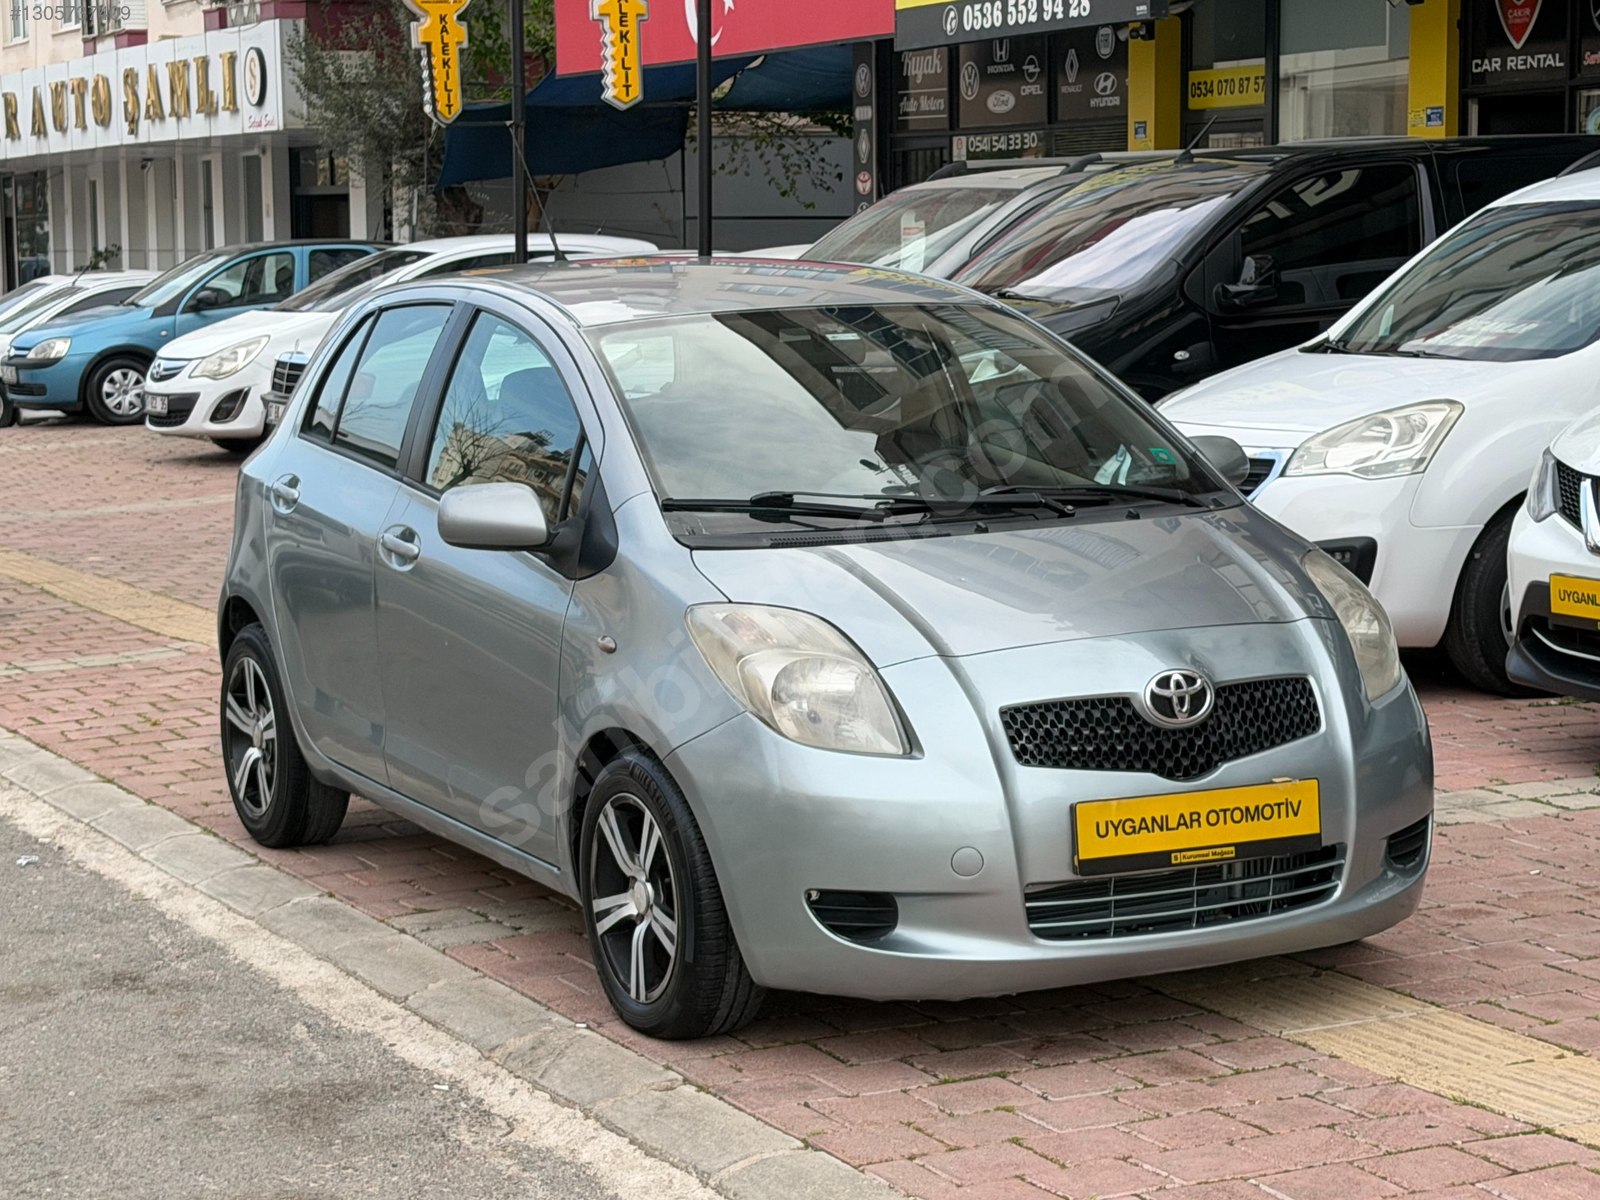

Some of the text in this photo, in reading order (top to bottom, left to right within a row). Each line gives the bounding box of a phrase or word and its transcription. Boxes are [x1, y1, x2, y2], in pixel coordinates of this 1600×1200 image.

[963, 5, 1003, 31] 0536
[1007, 1, 1038, 26] 552
[1043, 0, 1064, 21] 94
[986, 64, 1015, 74] HONDA
[1472, 53, 1565, 73] CAR RENTAL
[30, 73, 112, 138] AUTO
[122, 50, 239, 136] ŞAMLI
[1020, 85, 1043, 96] OPEL
[1191, 75, 1265, 98] 0534 070 87 57
[1090, 96, 1120, 107] HYUNDAI
[1009, 134, 1022, 150] 33
[1024, 132, 1038, 148] 30
[1095, 797, 1302, 839] UYGANLAR OTOMOTİV
